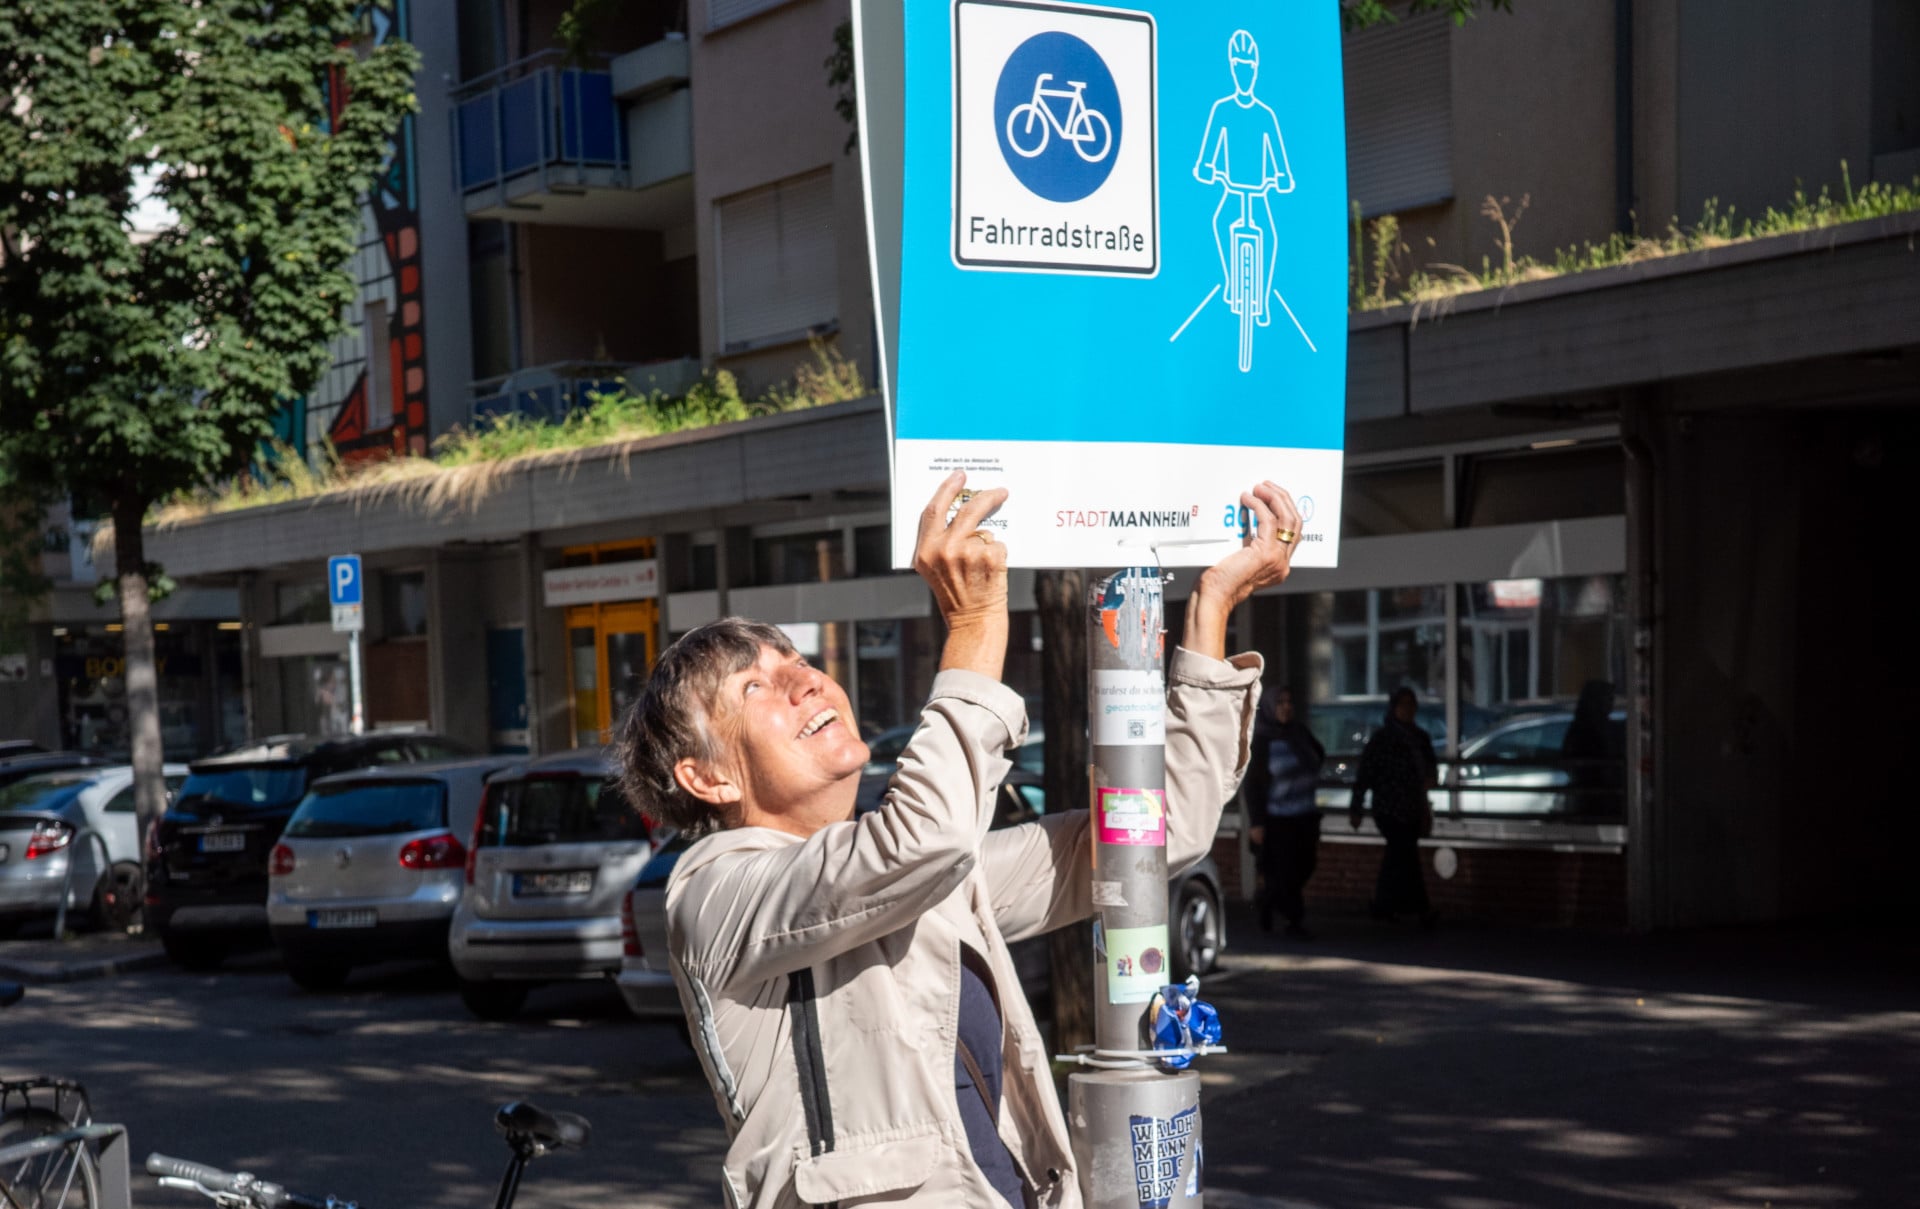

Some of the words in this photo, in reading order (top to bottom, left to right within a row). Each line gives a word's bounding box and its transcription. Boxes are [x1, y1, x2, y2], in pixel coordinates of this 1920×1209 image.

[970, 216, 1145, 252] Fahrradstraße
[336, 563, 354, 599] P
[1134, 1115, 1195, 1140] WALDH
